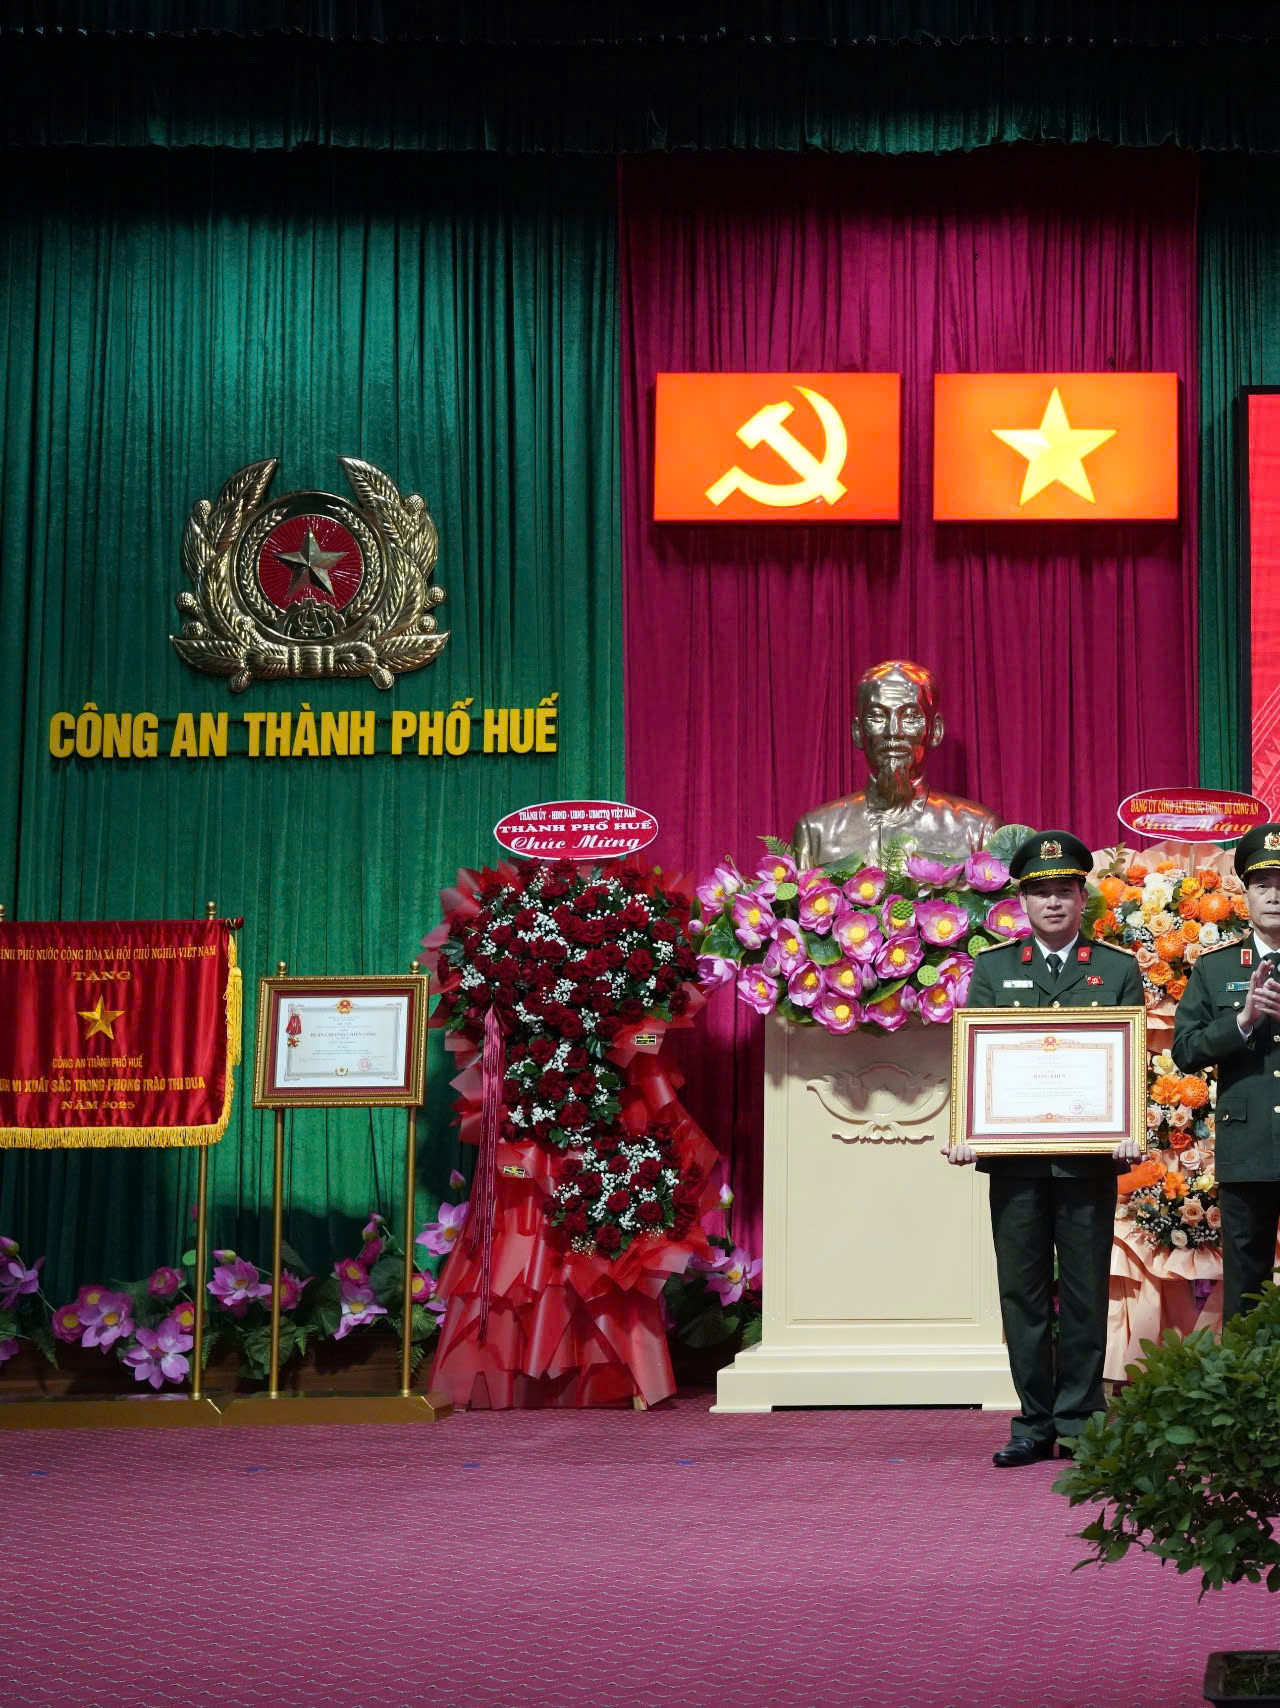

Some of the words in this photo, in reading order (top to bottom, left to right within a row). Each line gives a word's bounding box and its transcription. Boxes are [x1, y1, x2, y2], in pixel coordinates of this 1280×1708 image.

[49, 701, 159, 758] CÔNG
[169, 712, 229, 757] AN
[243, 702, 375, 757] THÀNH
[391, 697, 475, 756] PHỐ
[483, 692, 560, 754] HUẾ
[519, 809, 538, 820] THÀNH
[610, 806, 624, 820] VIỆT
[624, 808, 637, 818] NAM
[499, 823, 566, 834] THÀNH
[571, 820, 609, 831] PHỐ
[613, 818, 653, 830] HUẾ
[511, 836, 567, 850] Chúc
[571, 834, 641, 850] Mừng
[85, 946, 102, 960] HÒA
[178, 944, 197, 960] VIỆT
[198, 945, 217, 957] NAM
[75, 1058, 86, 1068] AN
[74, 1079, 106, 1092] TRONG
[107, 1078, 141, 1092] PHONG
[143, 1076, 166, 1092] TRÀO
[167, 1077, 184, 1091] THI
